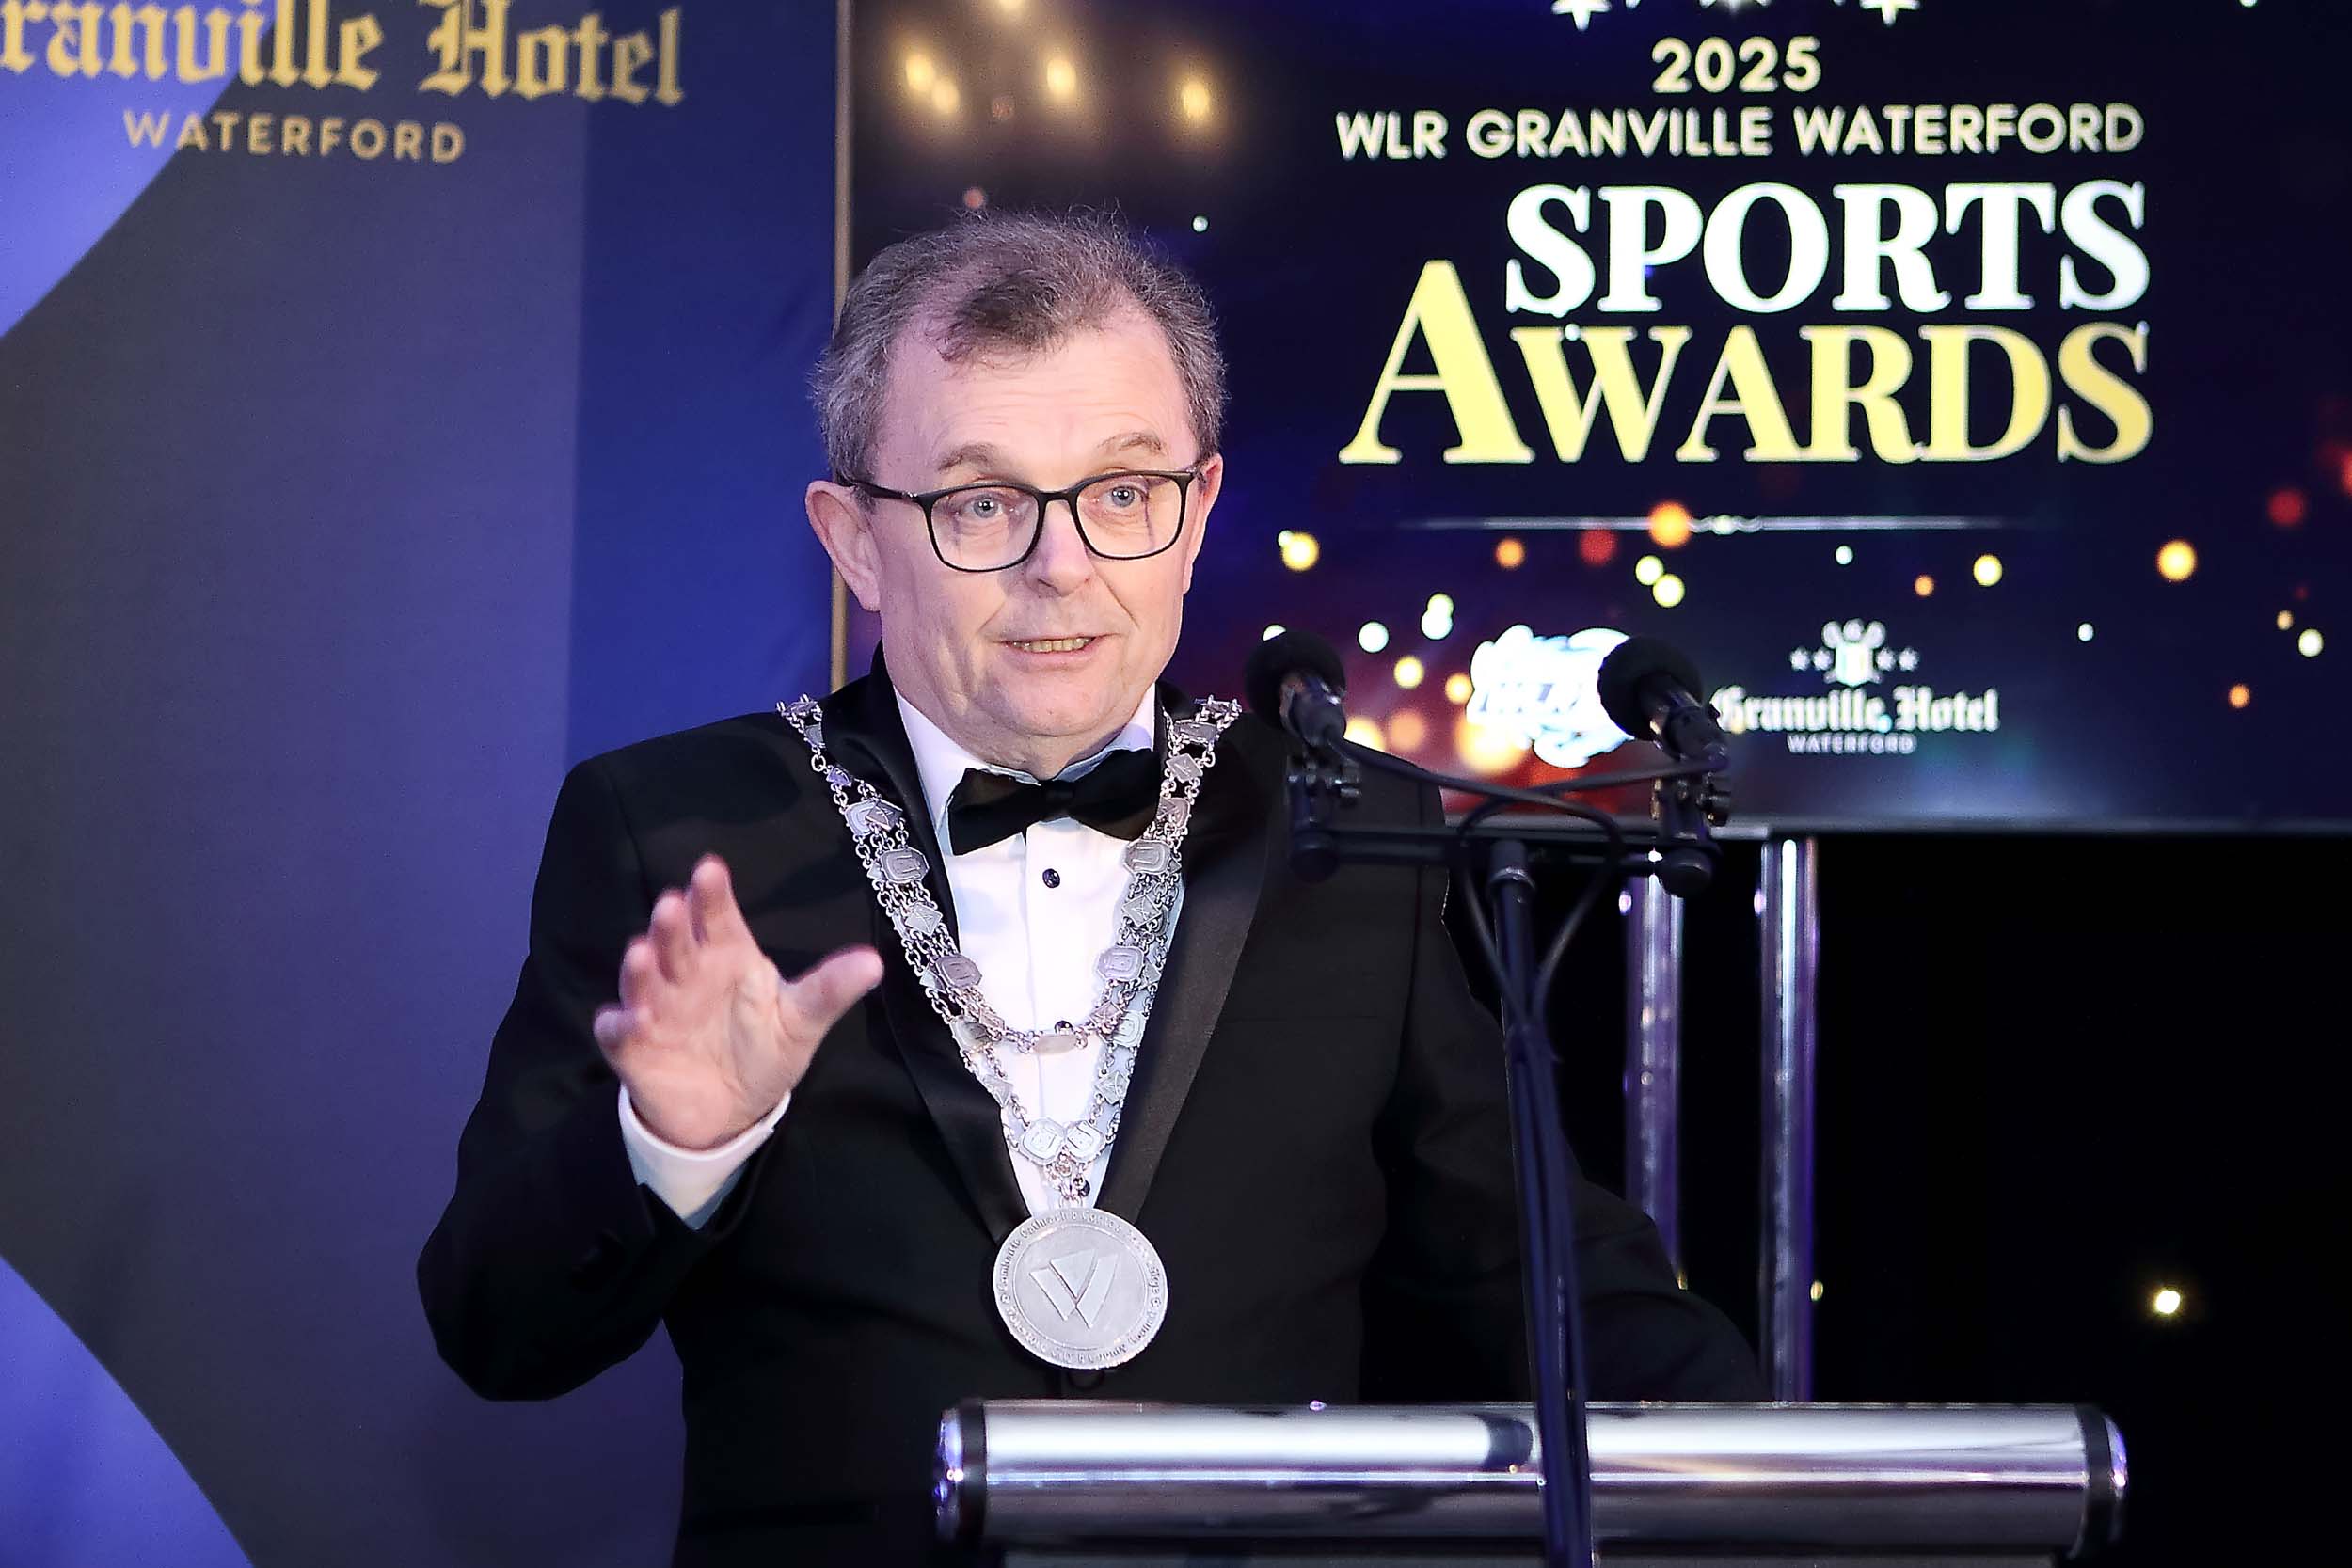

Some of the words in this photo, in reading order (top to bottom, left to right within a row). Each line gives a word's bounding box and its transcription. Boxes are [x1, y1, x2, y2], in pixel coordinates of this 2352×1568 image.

[418, 0, 685, 106] Hotel
[1651, 36, 1822, 93] 2025
[123, 109, 467, 164] WATERFORD
[1335, 110, 1449, 159] WLR
[1466, 106, 1773, 158] GRANVILLE
[1793, 102, 2145, 155] WATERFORD
[1505, 180, 2151, 315] SPORTS
[1709, 685, 1885, 733] Granville
[1892, 685, 2000, 733] Hotel
[1788, 732, 1917, 754] WATERFORD
